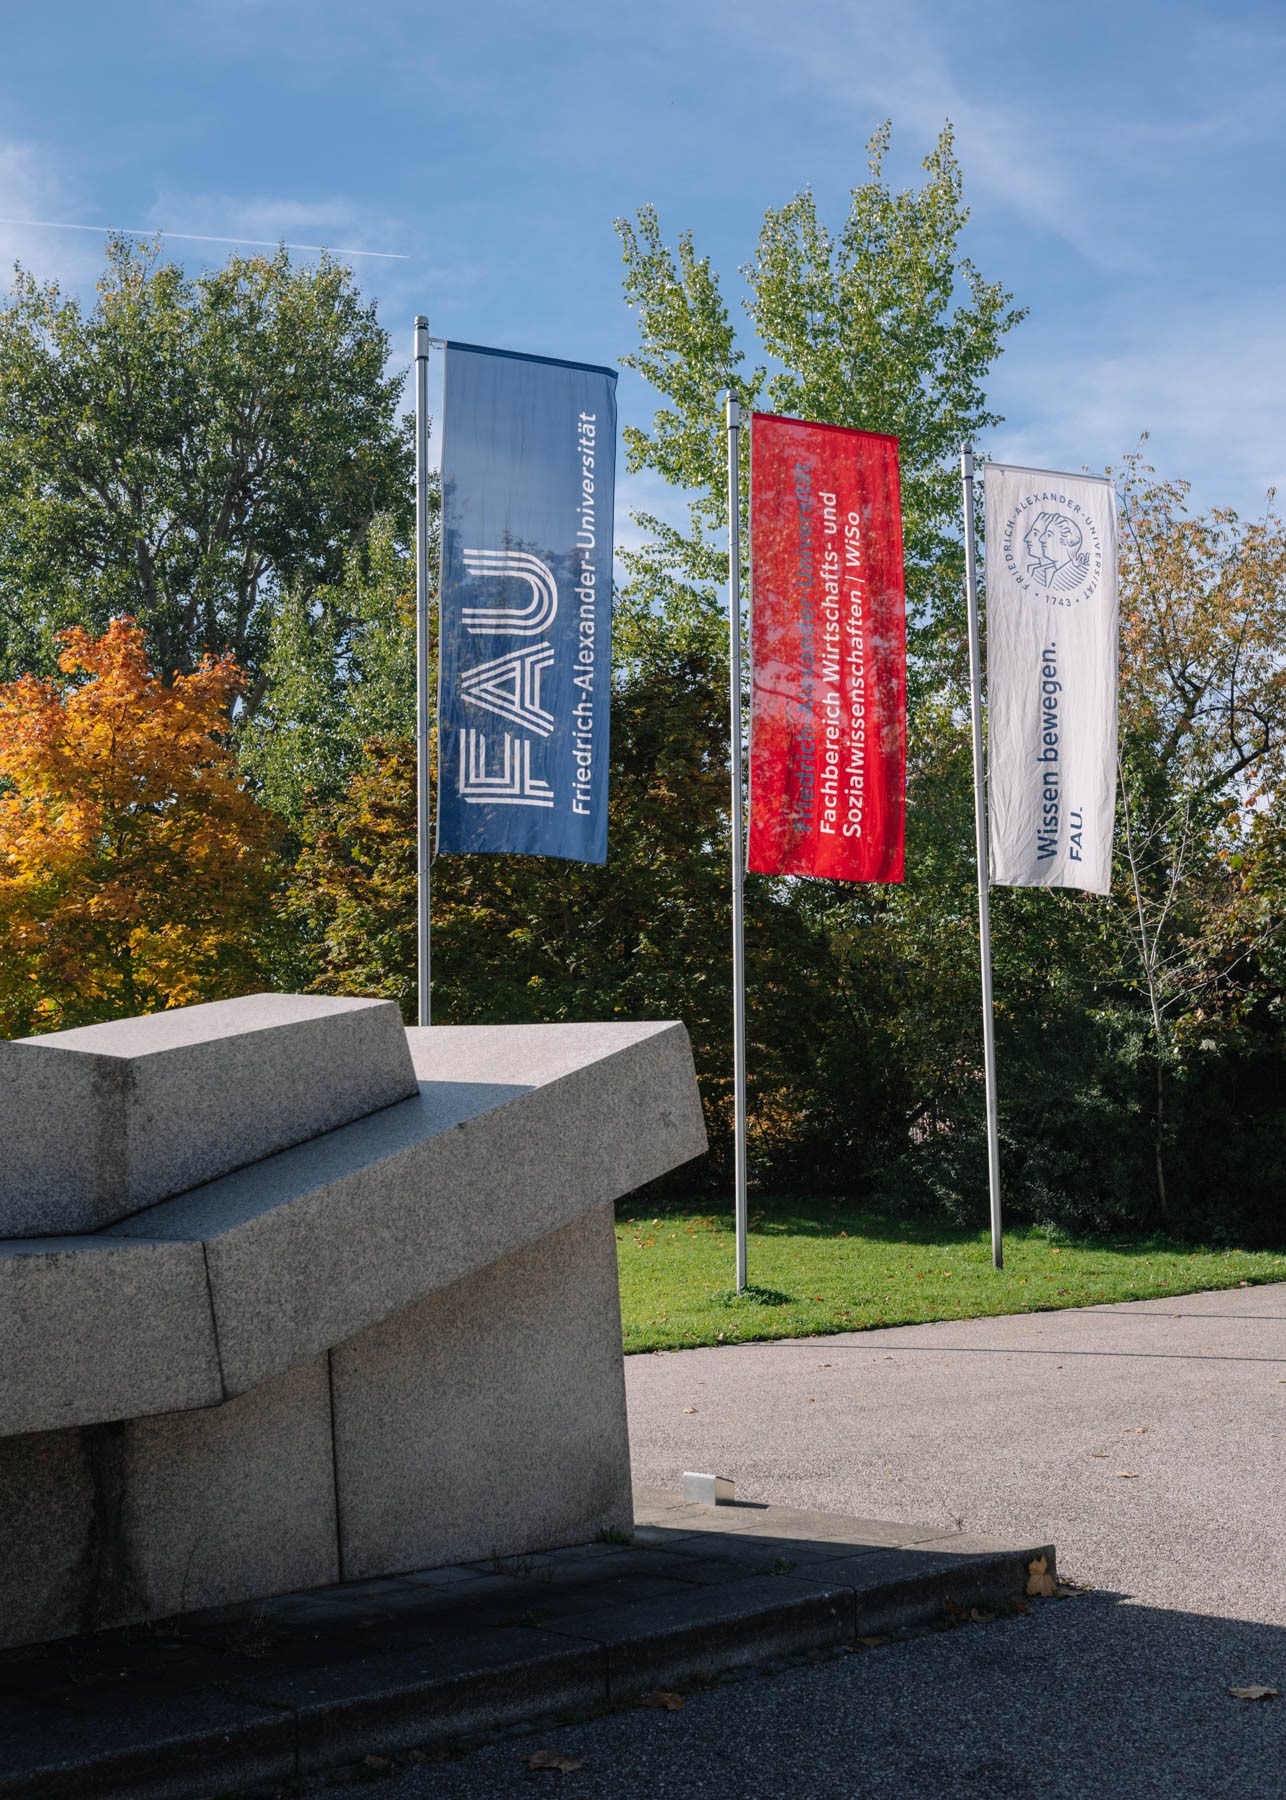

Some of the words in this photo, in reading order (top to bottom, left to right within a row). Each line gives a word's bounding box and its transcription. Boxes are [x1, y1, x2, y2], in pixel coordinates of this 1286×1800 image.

[817, 491, 838, 536] und
[843, 511, 862, 568] WiSo
[571, 411, 598, 817] Friedrich-Alexander-Universität
[793, 463, 817, 833] Friedrich-Alexander-Universität
[818, 542, 840, 683] Wirtschafts-
[1045, 595, 1072, 607] 1743
[459, 549, 559, 808] FAU
[842, 590, 866, 839] Sozialwissenschaften
[1036, 641, 1062, 763] bewegen.
[819, 692, 841, 836] Fachbereich
[1036, 771, 1059, 862] Wissen
[1069, 806, 1083, 862] FAU.
